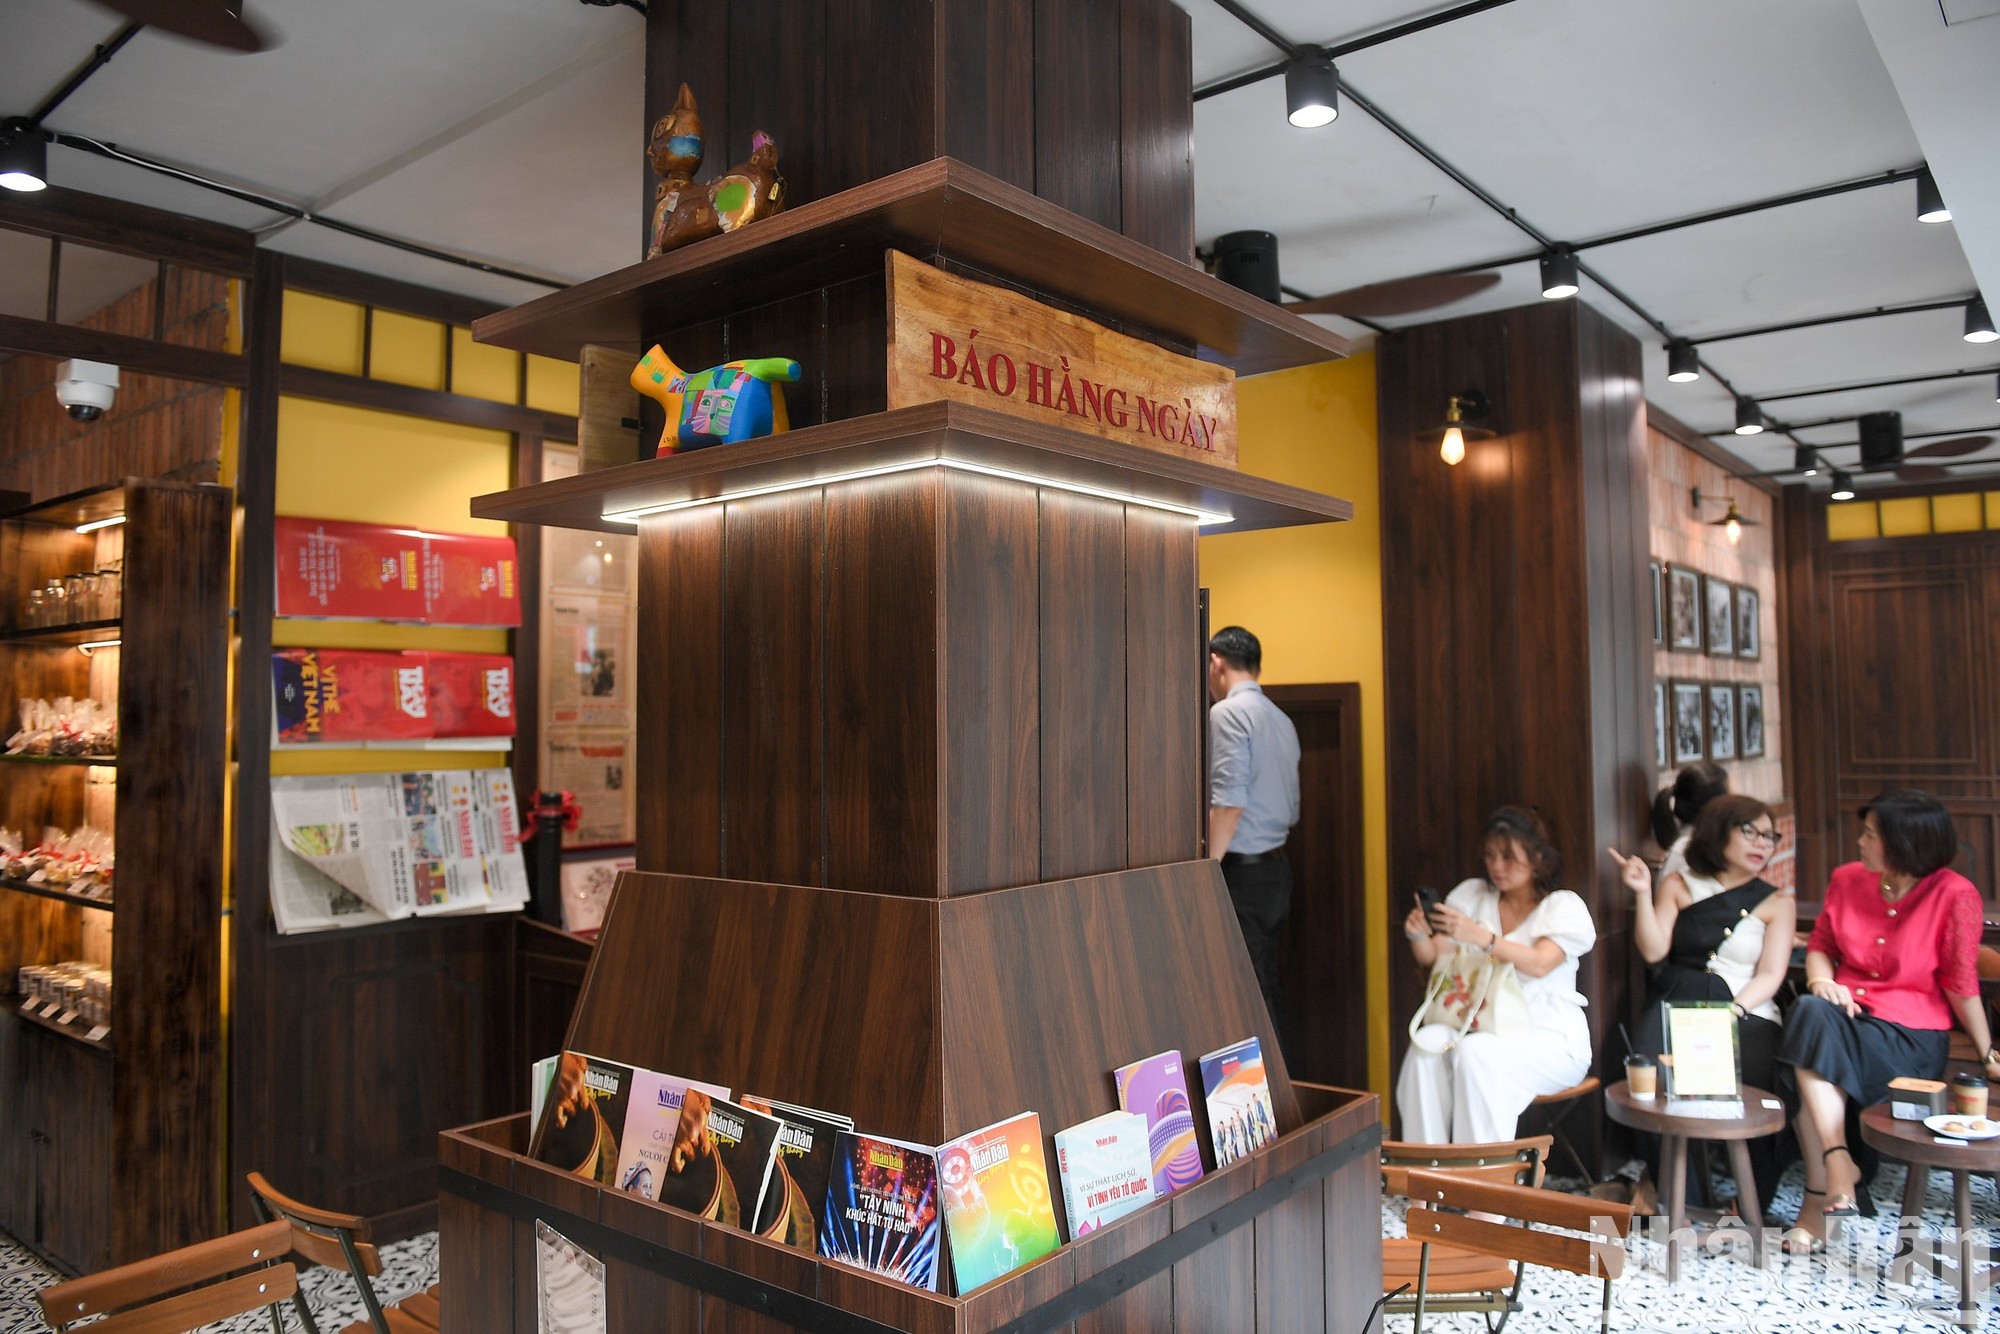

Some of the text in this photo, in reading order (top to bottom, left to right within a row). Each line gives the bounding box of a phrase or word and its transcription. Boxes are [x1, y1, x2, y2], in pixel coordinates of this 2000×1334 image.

[930, 329, 1218, 453] BÁO HẰNG NGÀY
[303, 690, 321, 733] NAM
[585, 1069, 604, 1087] Nhân
[603, 1077, 619, 1092] Dân
[658, 1089, 680, 1107] Nhân
[707, 1111, 727, 1133] Nhân
[727, 1120, 744, 1140] Dân
[780, 1125, 813, 1149] ân Dân
[869, 1150, 889, 1166] Nhân
[889, 1155, 904, 1169] Dân
[990, 1143, 1009, 1162] Dân
[1109, 1185, 1121, 1200] YÊU
[1130, 1175, 1148, 1194] QUỐC
[845, 1207, 867, 1223] KHÚC
[867, 1211, 883, 1227] HÁT
[882, 1200, 906, 1218] NINH
